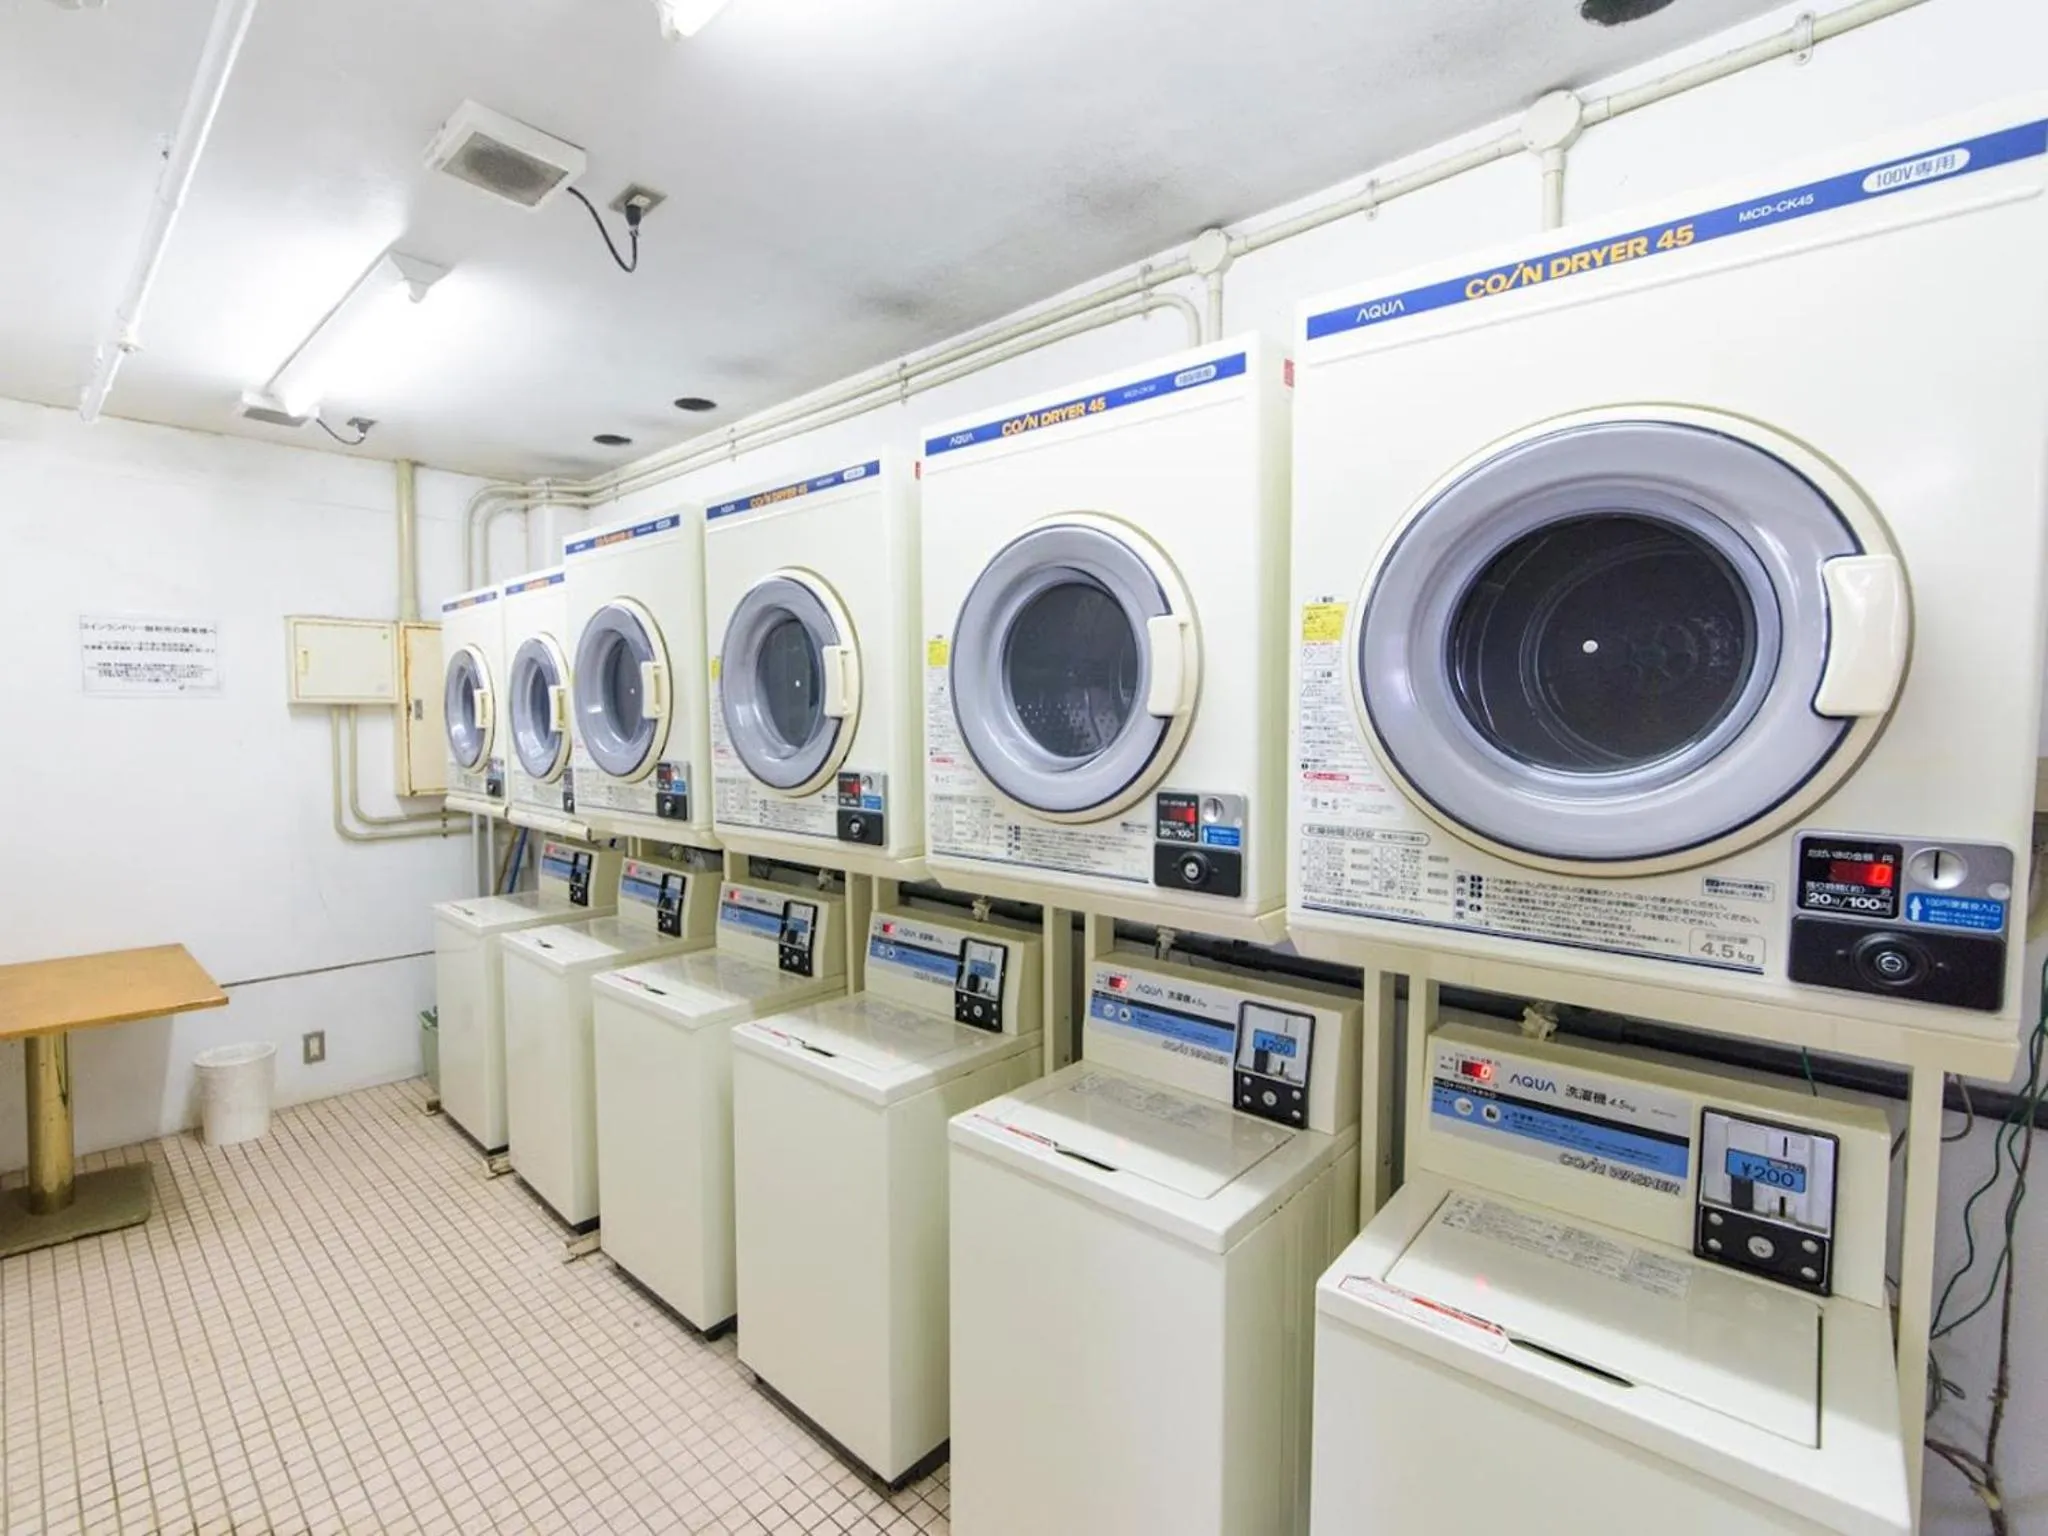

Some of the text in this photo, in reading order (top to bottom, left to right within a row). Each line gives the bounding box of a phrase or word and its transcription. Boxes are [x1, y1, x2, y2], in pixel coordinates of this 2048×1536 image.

[1739, 193, 1815, 223] MCD-CK45
[1550, 236, 1648, 278] DRYER
[1656, 224, 1694, 249] 45
[1356, 299, 1405, 323] AQUA
[1041, 402, 1086, 427] DRYER
[1088, 397, 1107, 413] 45
[949, 432, 975, 447] AQUA
[1136, 983, 1164, 997] AQUA
[1480, 1063, 1491, 1078] 0
[1509, 1074, 1557, 1094] AQUA
[1565, 1084, 1607, 1107] 洗濯機
[1742, 1161, 1795, 1188] ¥200
